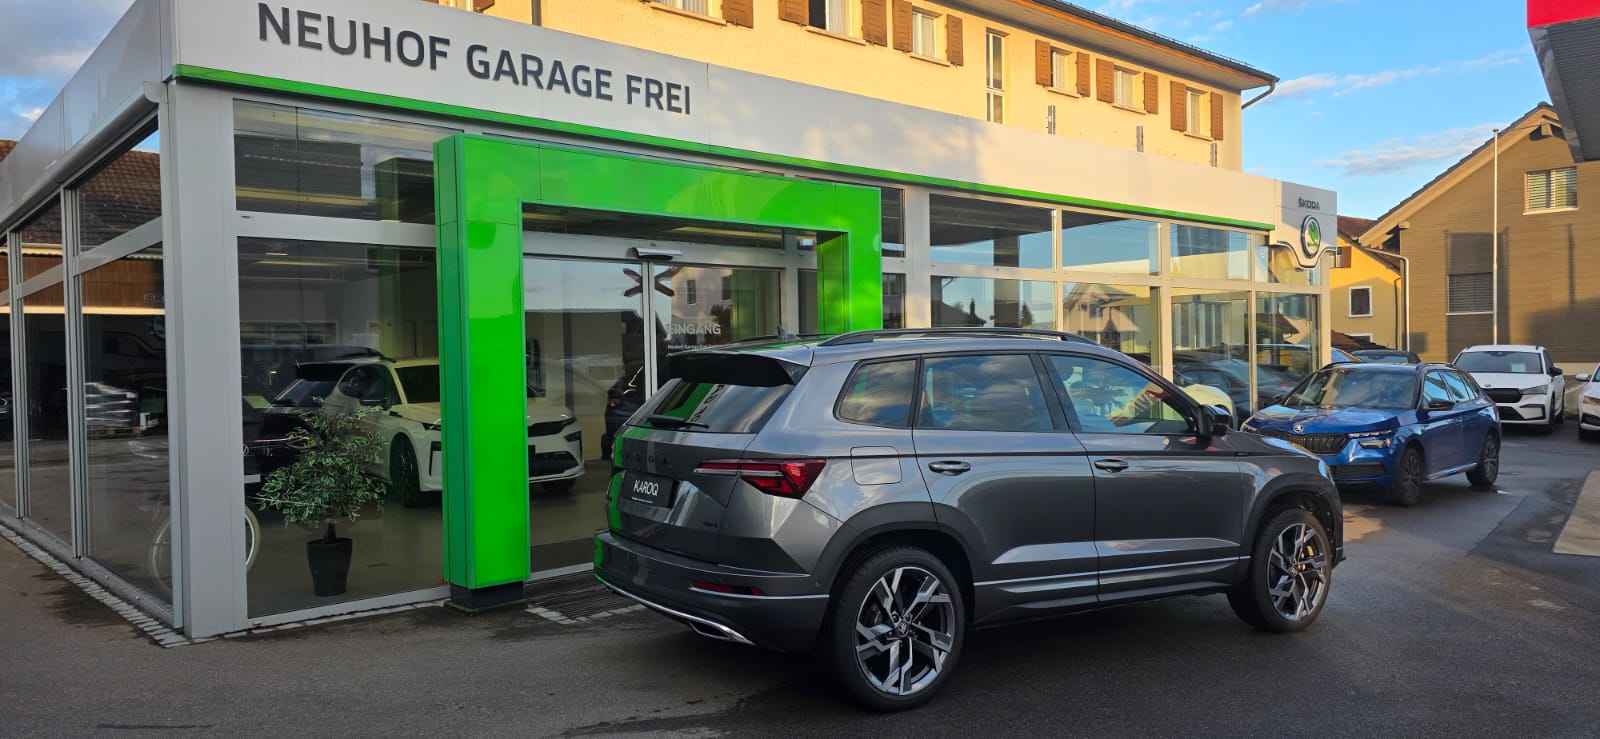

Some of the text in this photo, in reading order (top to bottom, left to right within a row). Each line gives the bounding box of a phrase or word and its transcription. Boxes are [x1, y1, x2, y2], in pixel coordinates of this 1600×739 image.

[257, 2, 691, 115] NEUHOF GARAGE FREI
[666, 322, 721, 335] EINGANG
[633, 479, 659, 497] KAROQ
